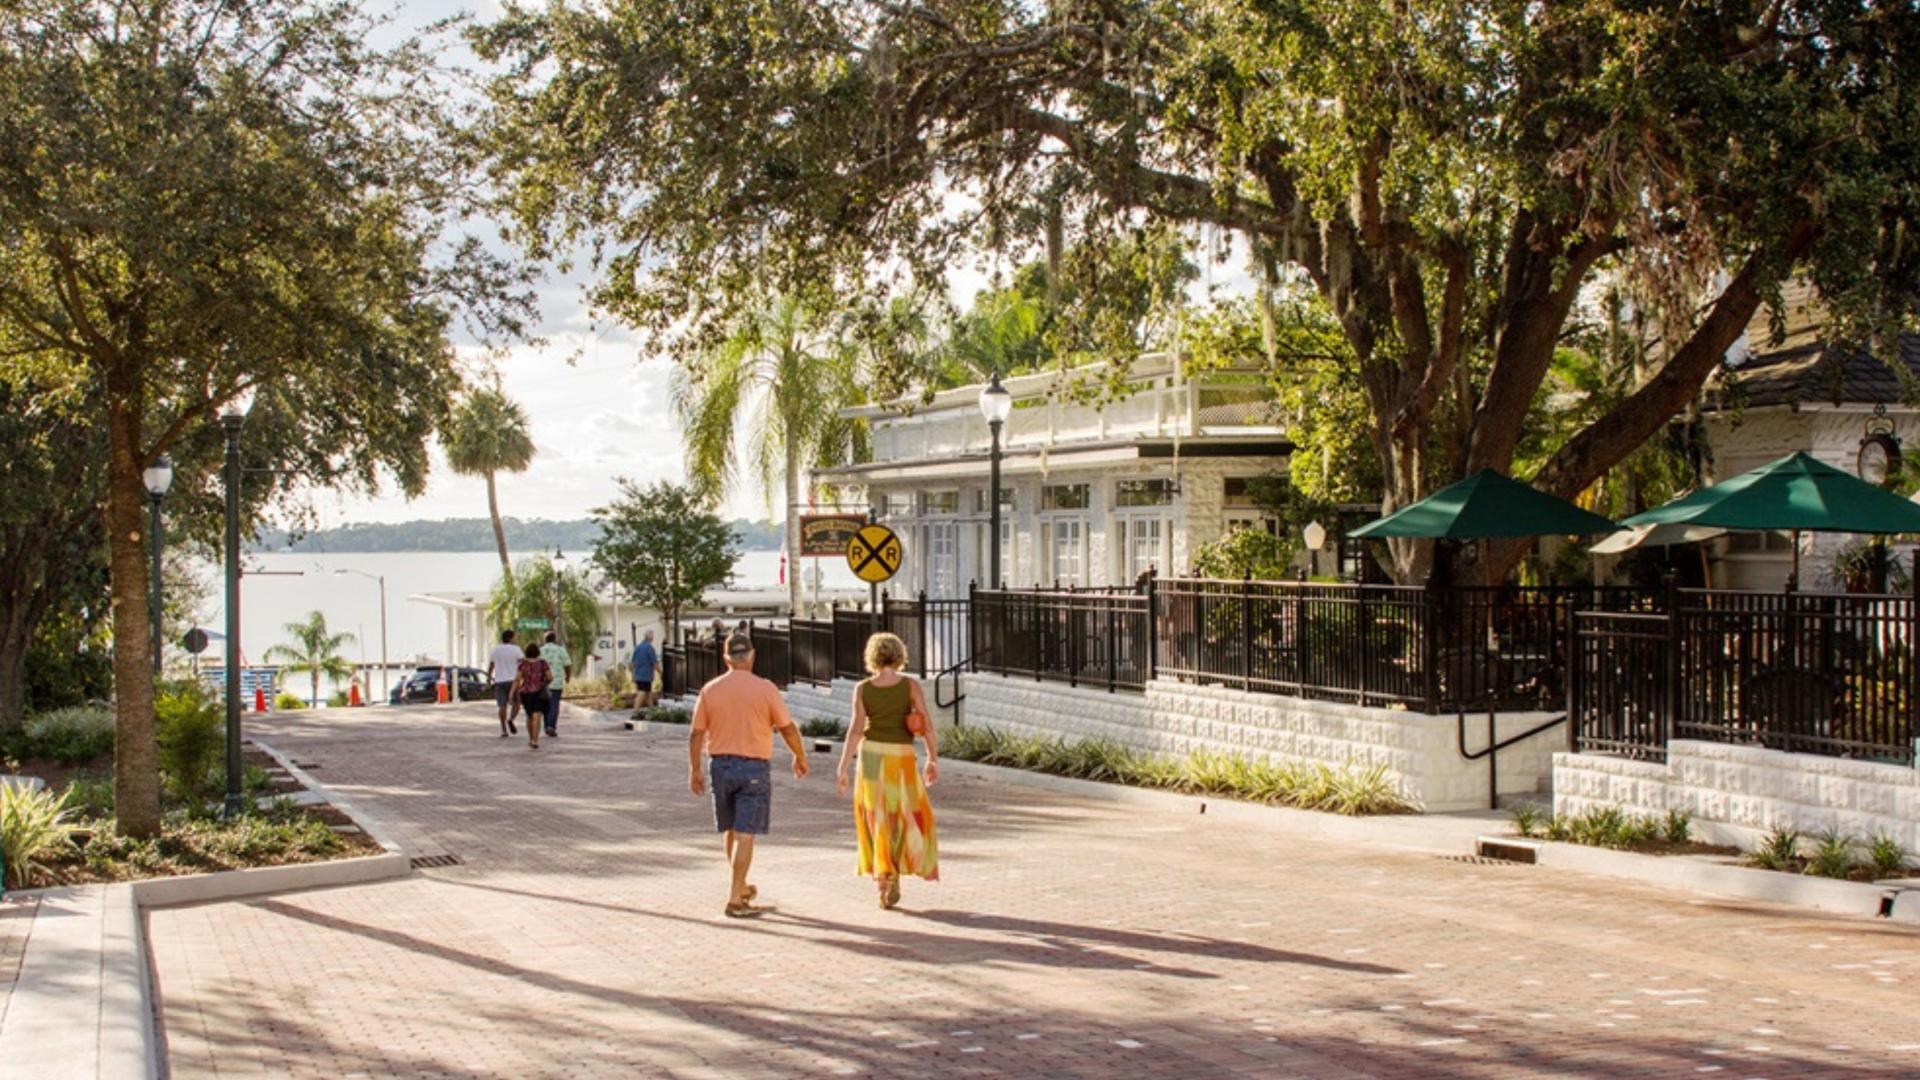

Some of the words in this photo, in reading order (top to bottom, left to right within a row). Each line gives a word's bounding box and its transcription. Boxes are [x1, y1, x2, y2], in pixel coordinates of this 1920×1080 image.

[852, 546, 863, 560] R
[886, 547, 897, 560] R
[599, 640, 626, 649] CLB
